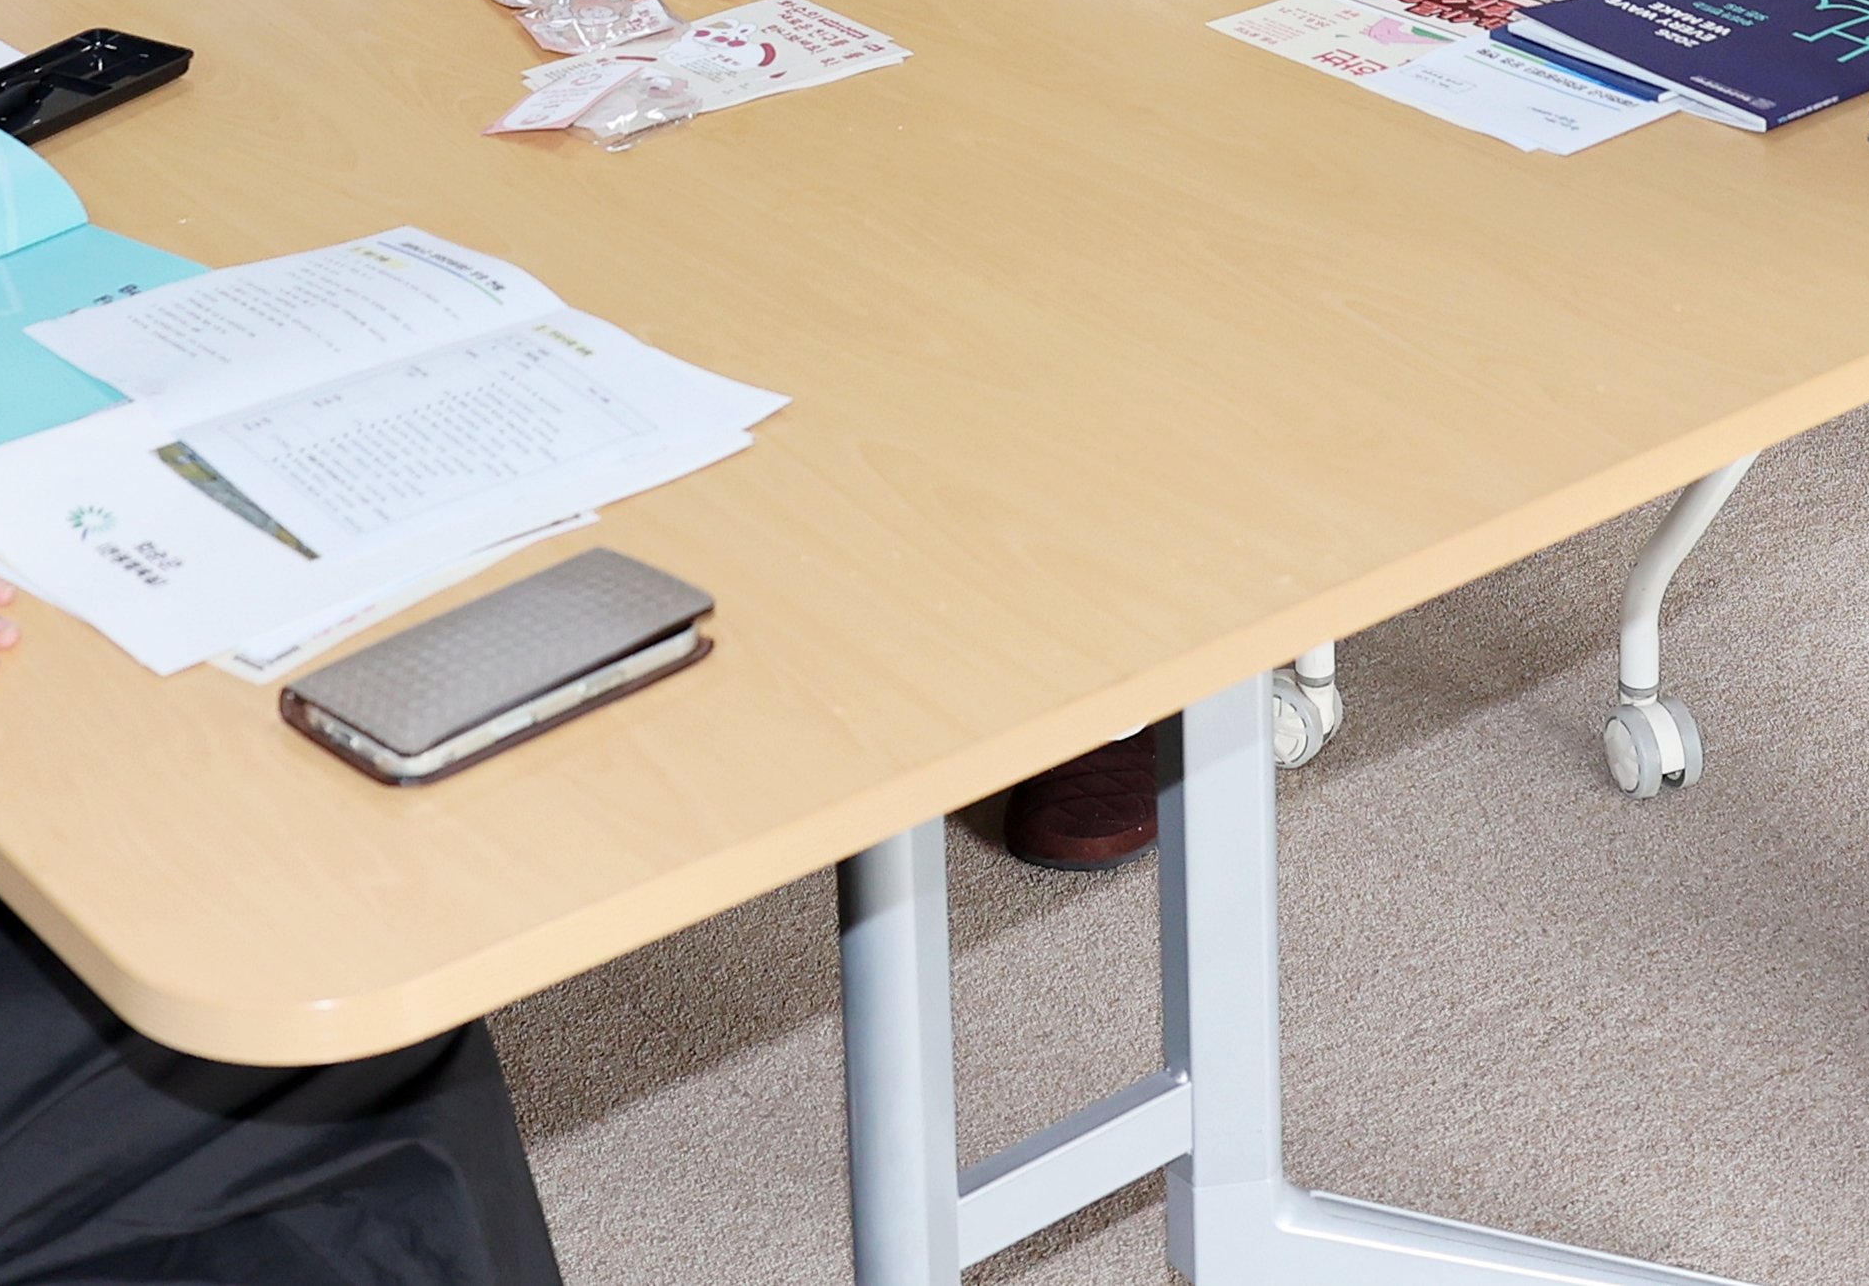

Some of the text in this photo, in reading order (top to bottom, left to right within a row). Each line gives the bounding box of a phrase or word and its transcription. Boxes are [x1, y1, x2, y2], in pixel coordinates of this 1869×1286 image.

[1648, 0, 1732, 37] WE MAKE
[1654, 15, 1718, 43] EVERY
